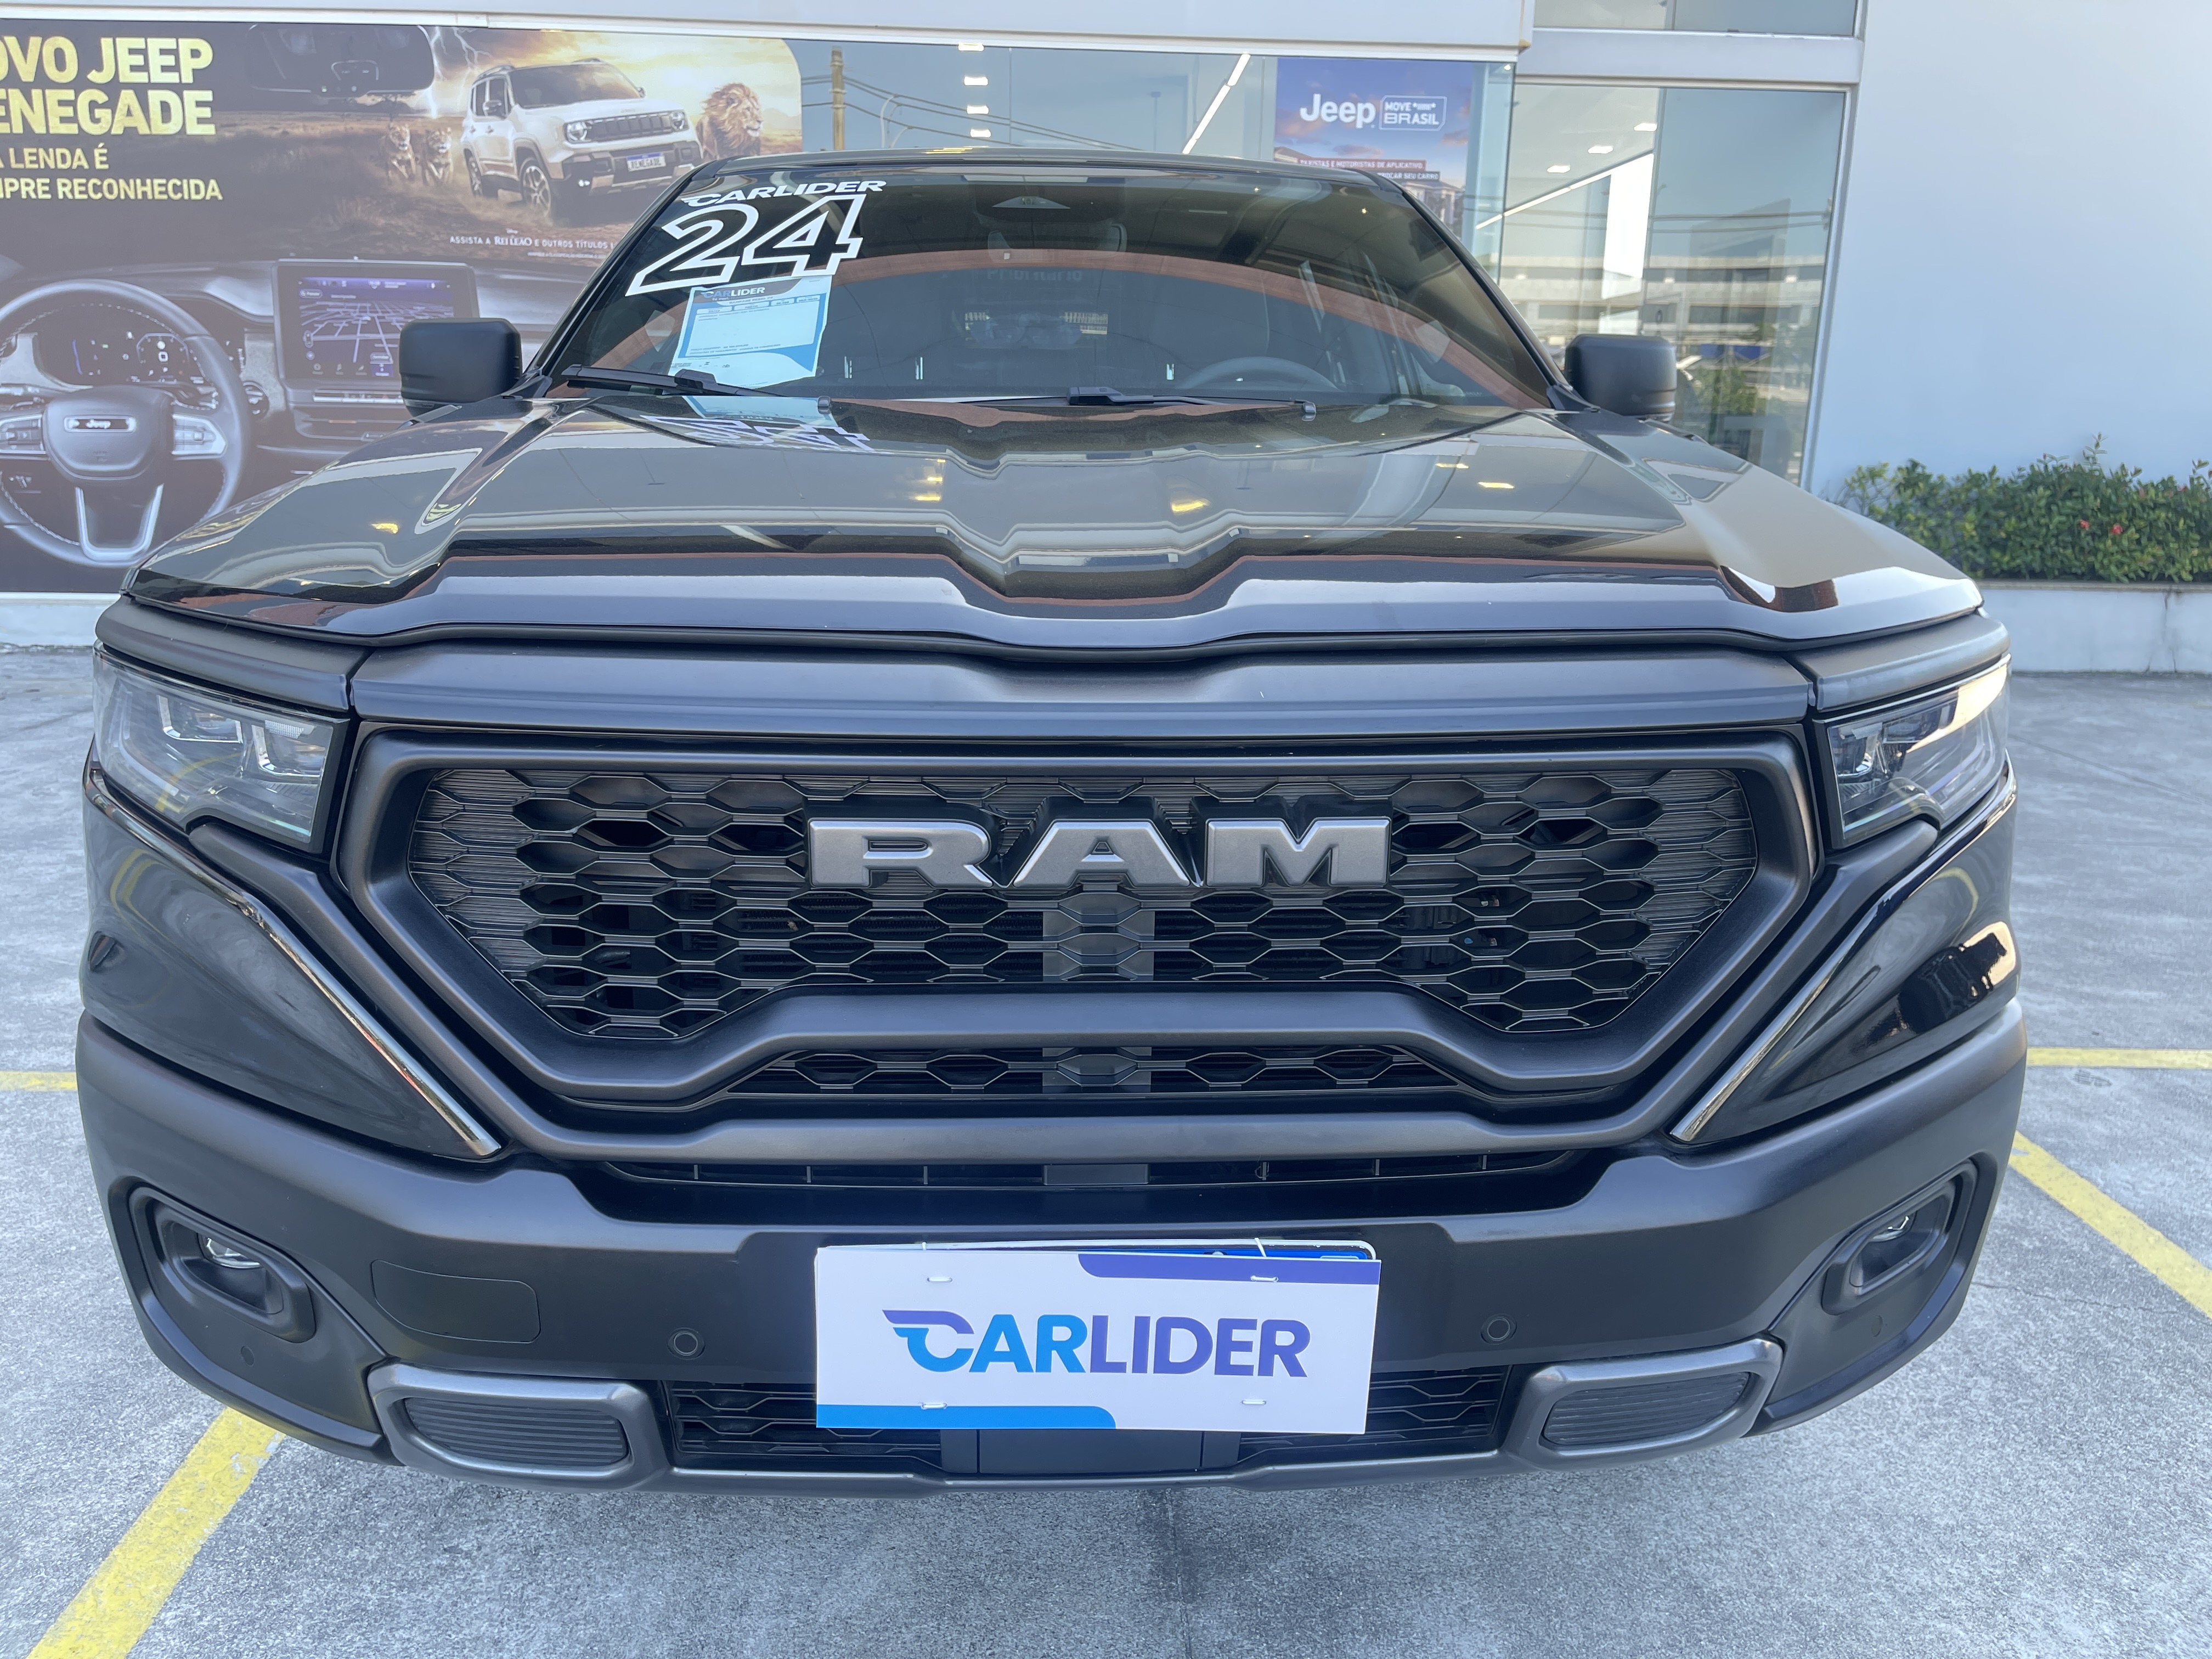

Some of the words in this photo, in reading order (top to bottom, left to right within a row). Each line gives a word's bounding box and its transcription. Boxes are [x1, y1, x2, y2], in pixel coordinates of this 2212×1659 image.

[87, 37, 213, 83] JEEP
[1300, 93, 1376, 129] Jeep
[1384, 112, 1439, 125] BRASIL
[1385, 101, 1412, 111] MOVE
[9, 147, 89, 170] LENDA
[94, 143, 109, 170] É
[0, 178, 51, 199] PRE
[57, 178, 223, 200] RECONHECIDA
[681, 180, 887, 207] CARLIDER
[449, 236, 483, 245] ASSISTA
[541, 240, 573, 248] OUTROS
[625, 194, 866, 296] 24
[701, 287, 765, 298] CARLIDER
[809, 817, 1391, 888] RAM
[882, 1310, 1311, 1377] CARLIDER
